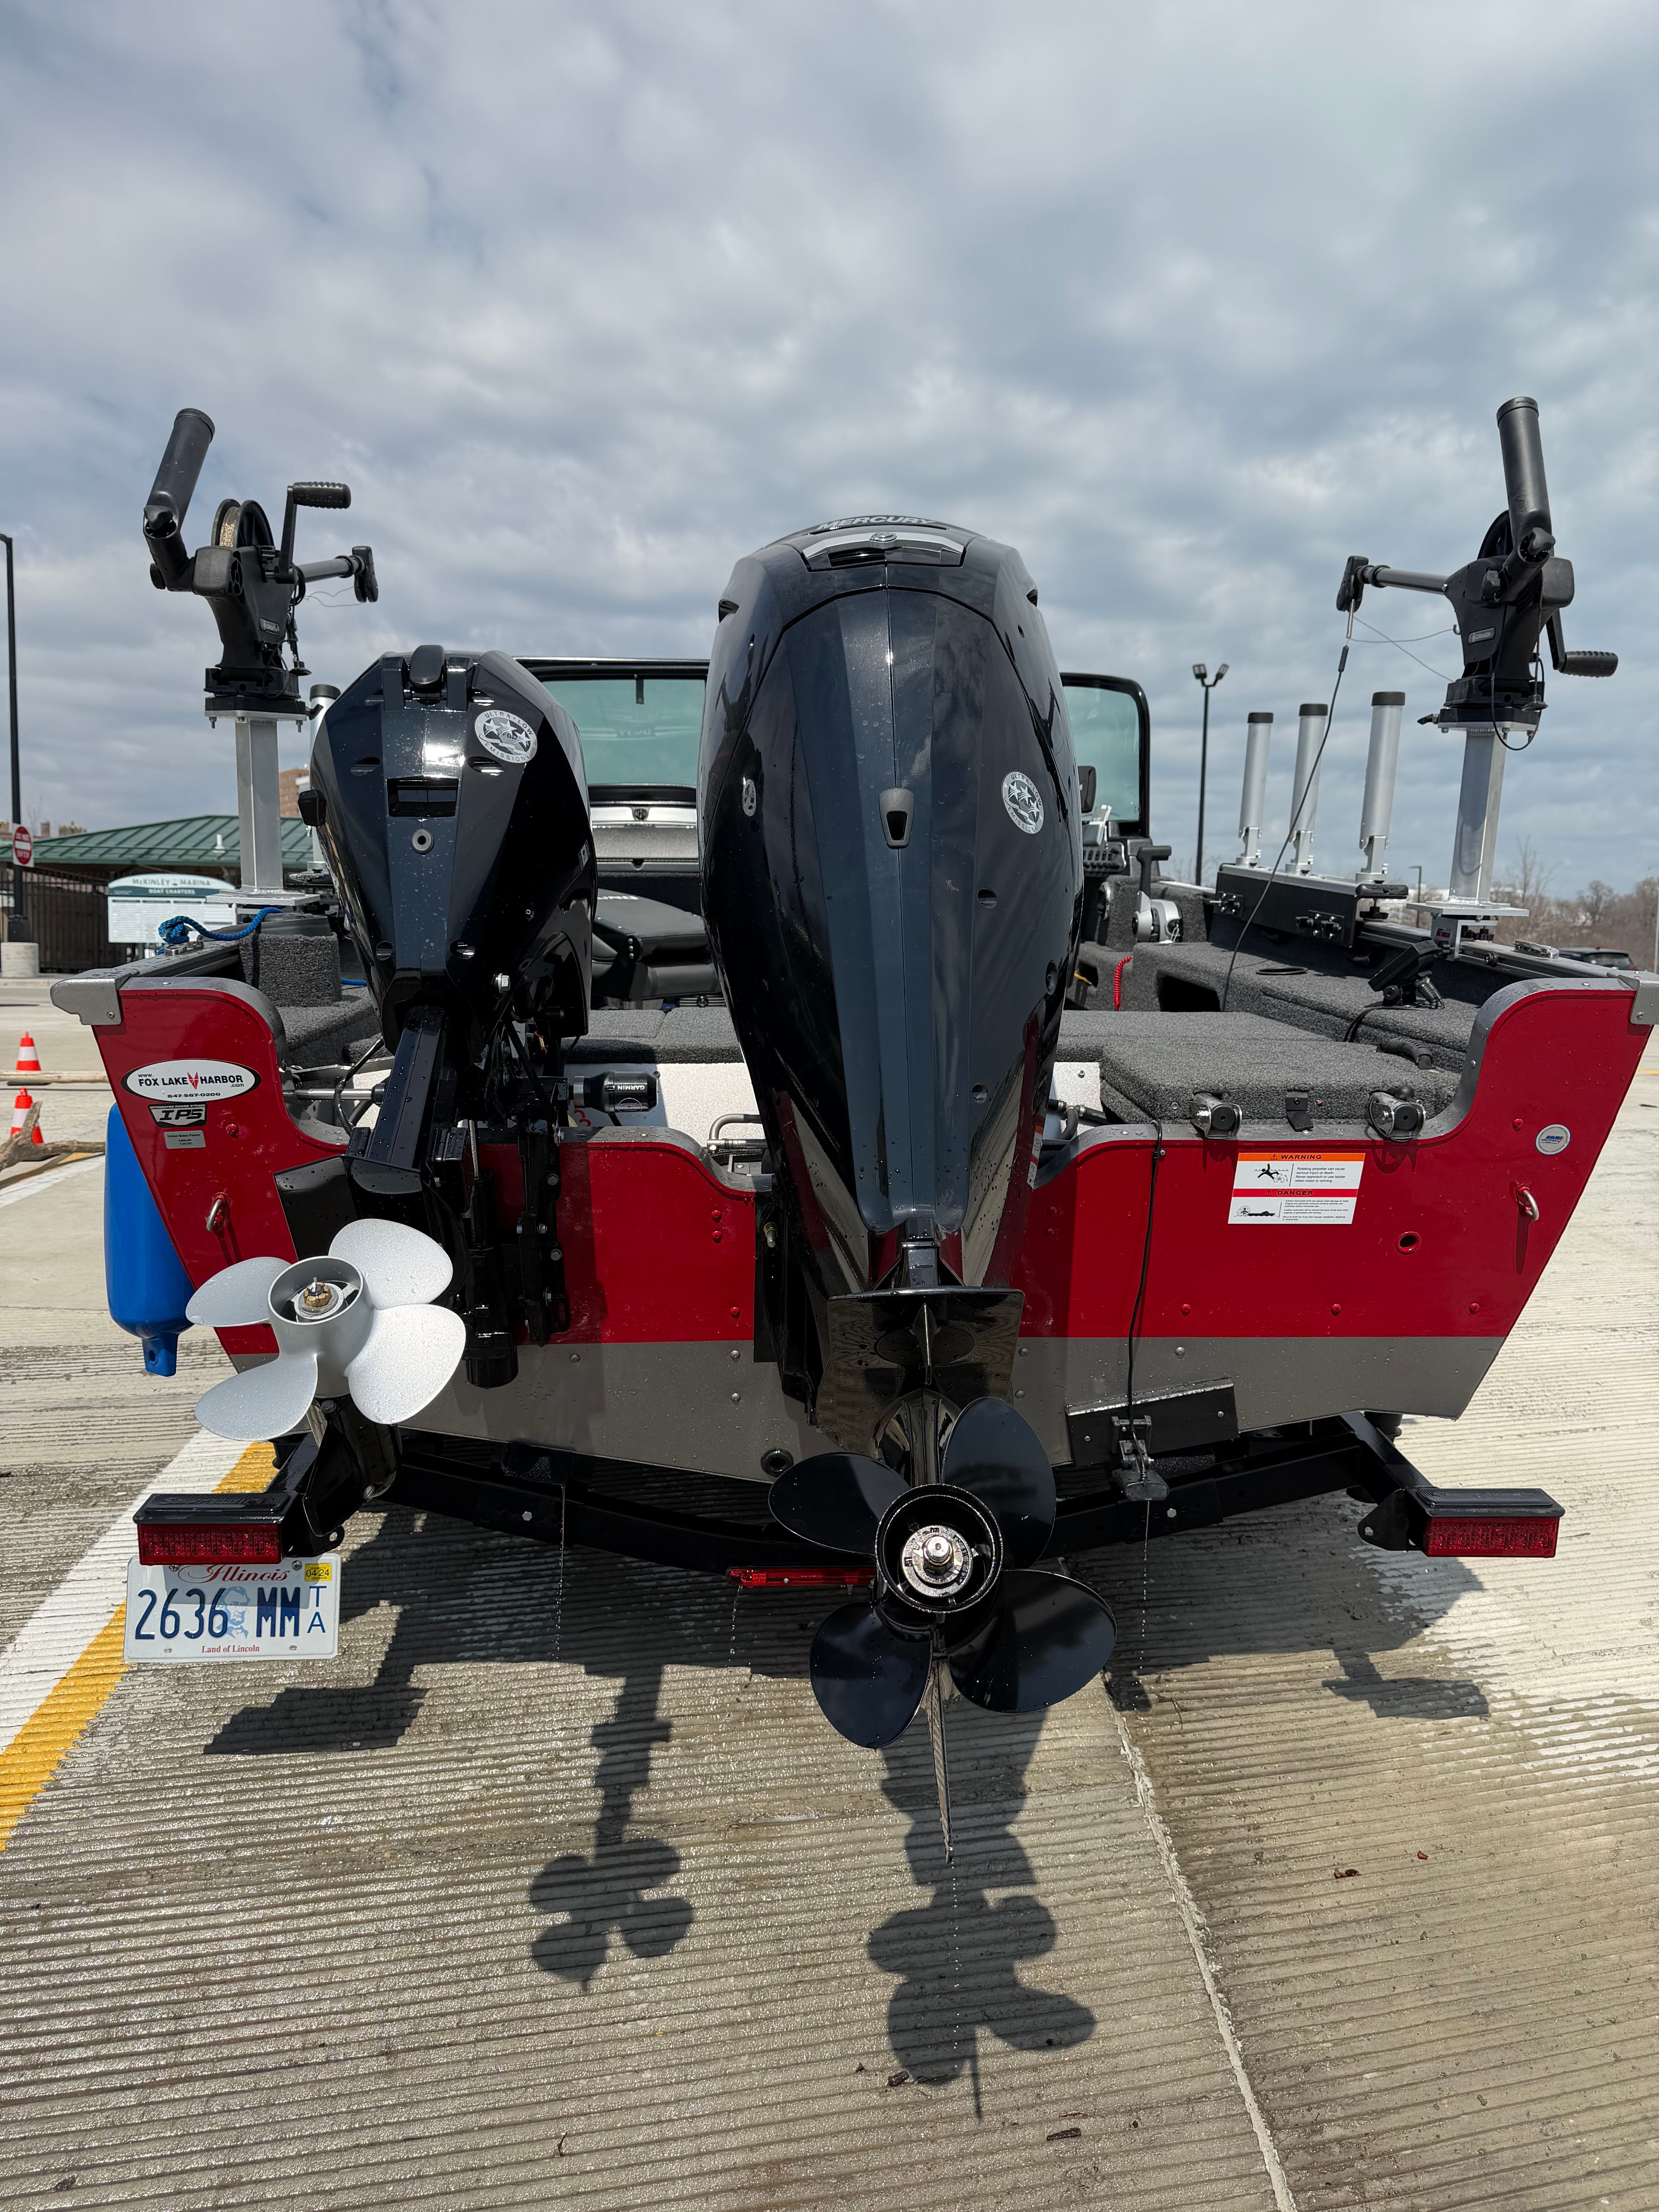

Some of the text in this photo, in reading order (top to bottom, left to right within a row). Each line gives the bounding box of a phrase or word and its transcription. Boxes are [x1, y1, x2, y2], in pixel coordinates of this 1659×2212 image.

[815, 516, 936, 531] MERCURY
[518, 720, 533, 735] LOW
[485, 742, 526, 762] EMISSION
[1011, 774, 1029, 784] ULTRA
[1032, 787, 1042, 805] LOW
[1008, 807, 1035, 833] EMISSION
[139, 1075, 243, 1087] FOX LAKE HARBOR
[159, 1109, 203, 1121] IPS
[178, 1564, 290, 1583] Illinois
[135, 1587, 301, 1640] 2636 MM
[201, 1644, 260, 1654] Land of Lincoln
